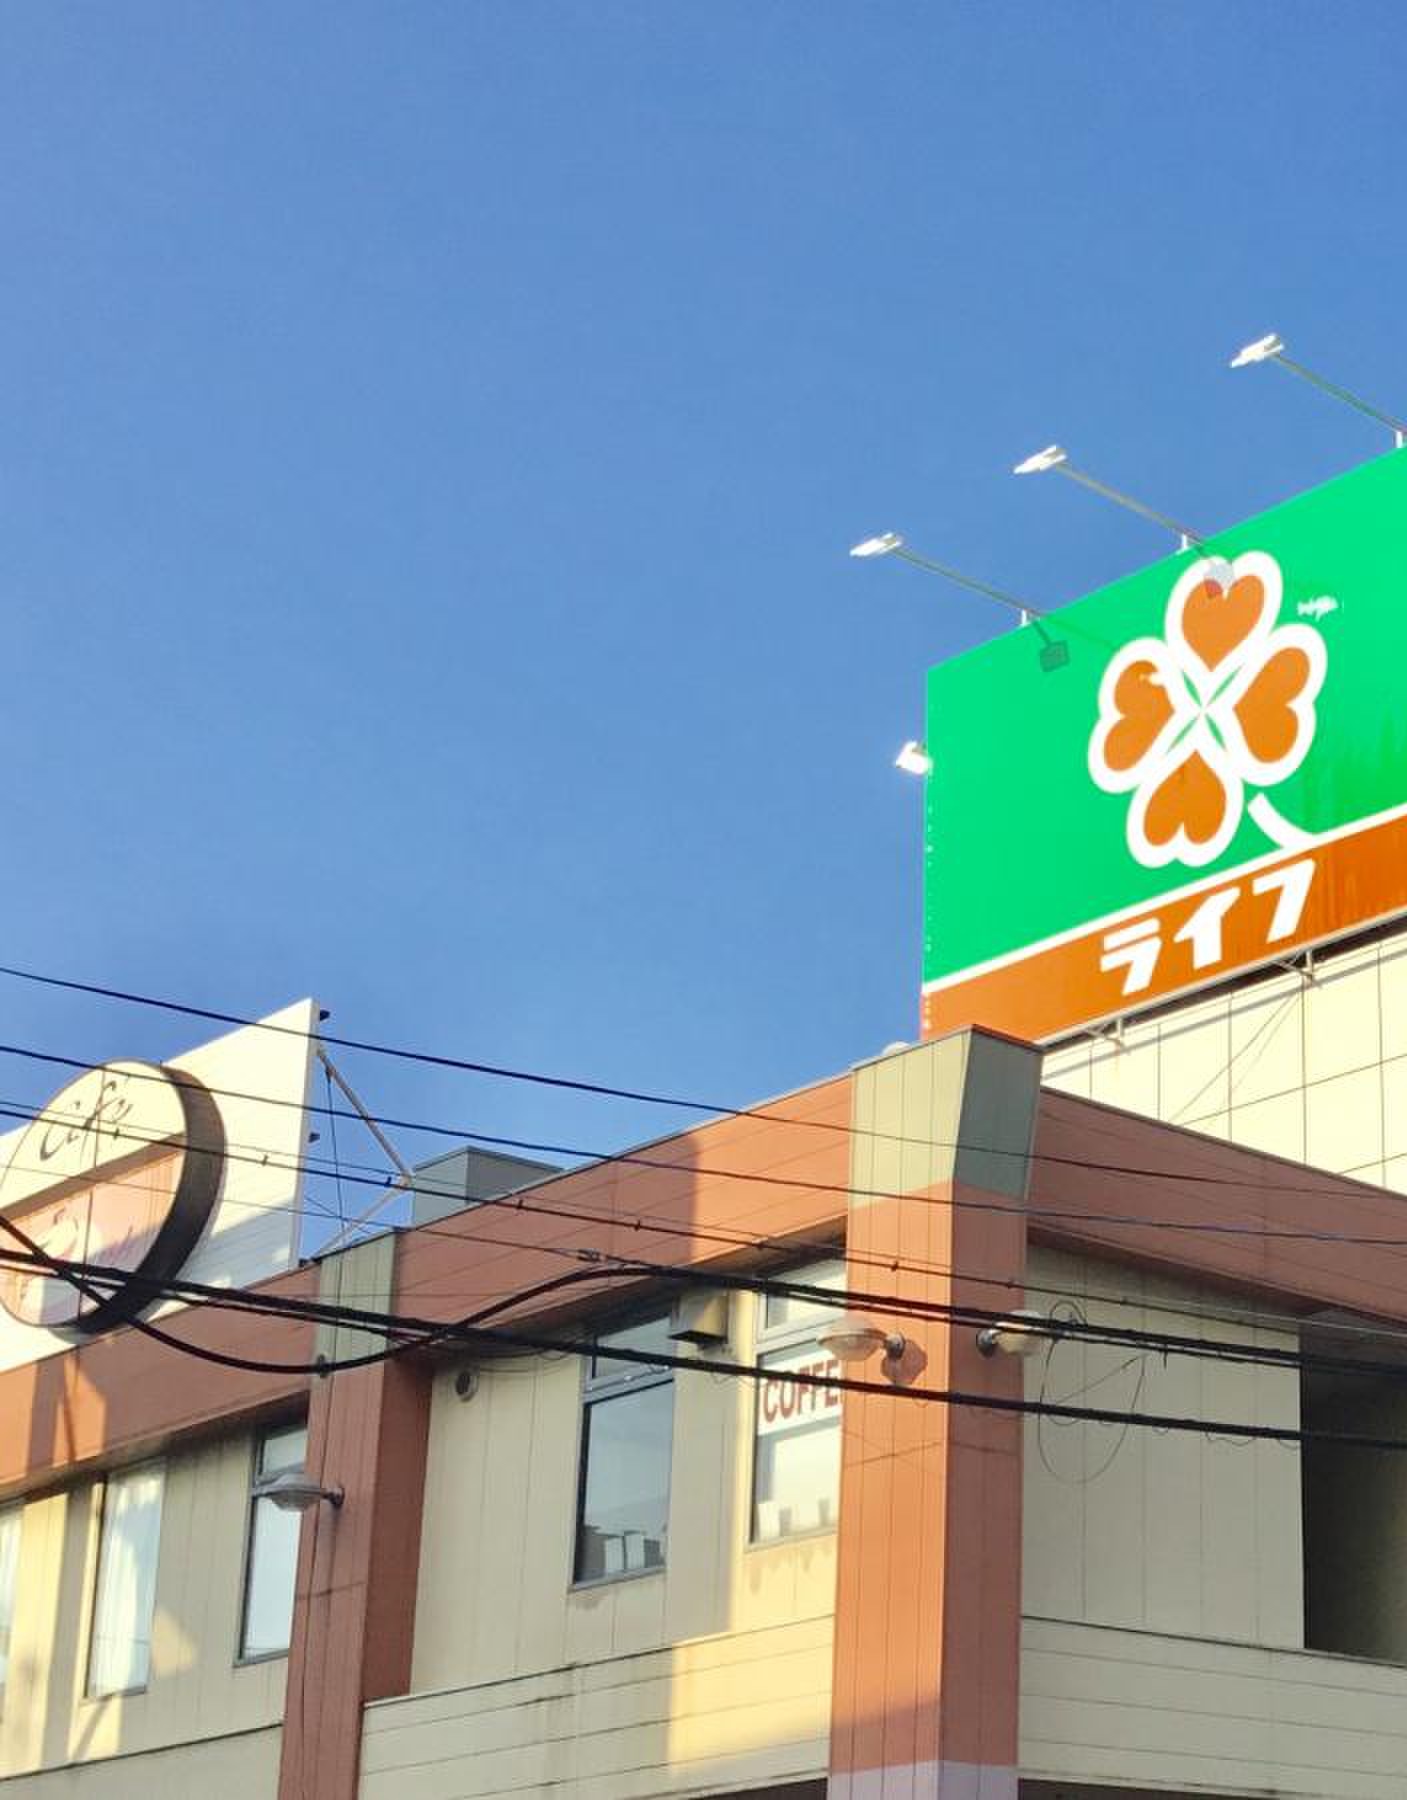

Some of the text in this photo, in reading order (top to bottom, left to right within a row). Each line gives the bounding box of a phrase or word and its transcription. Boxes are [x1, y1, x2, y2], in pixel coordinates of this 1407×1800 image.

[1101, 859, 1316, 996] ライフ
[763, 1358, 843, 1422] COFFE
